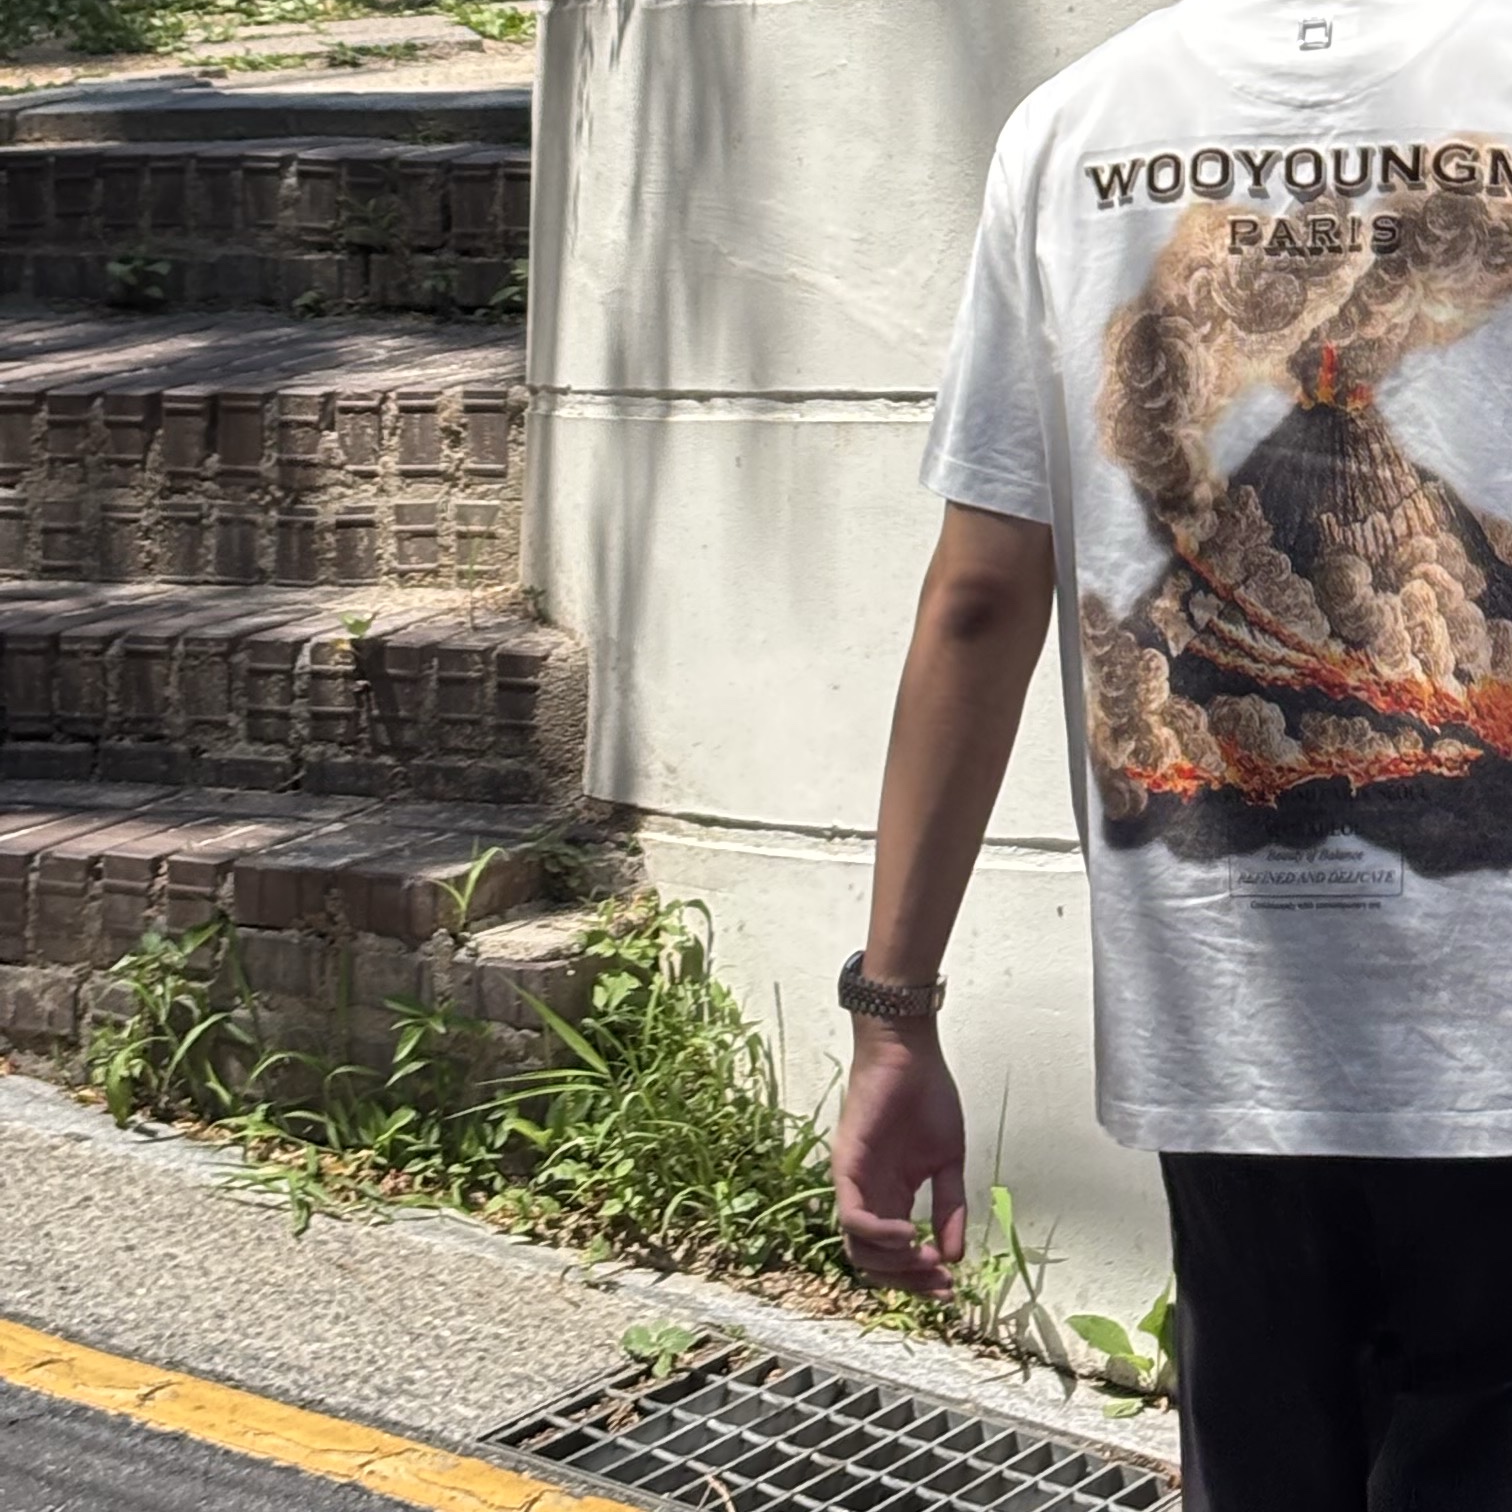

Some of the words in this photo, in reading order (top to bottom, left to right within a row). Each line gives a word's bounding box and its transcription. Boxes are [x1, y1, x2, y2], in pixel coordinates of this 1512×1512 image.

[1227, 214, 1402, 256] PARIS
[1238, 871, 1295, 885] REFINED
[1296, 871, 1326, 884] AND
[1328, 870, 1395, 884] DELICATE
